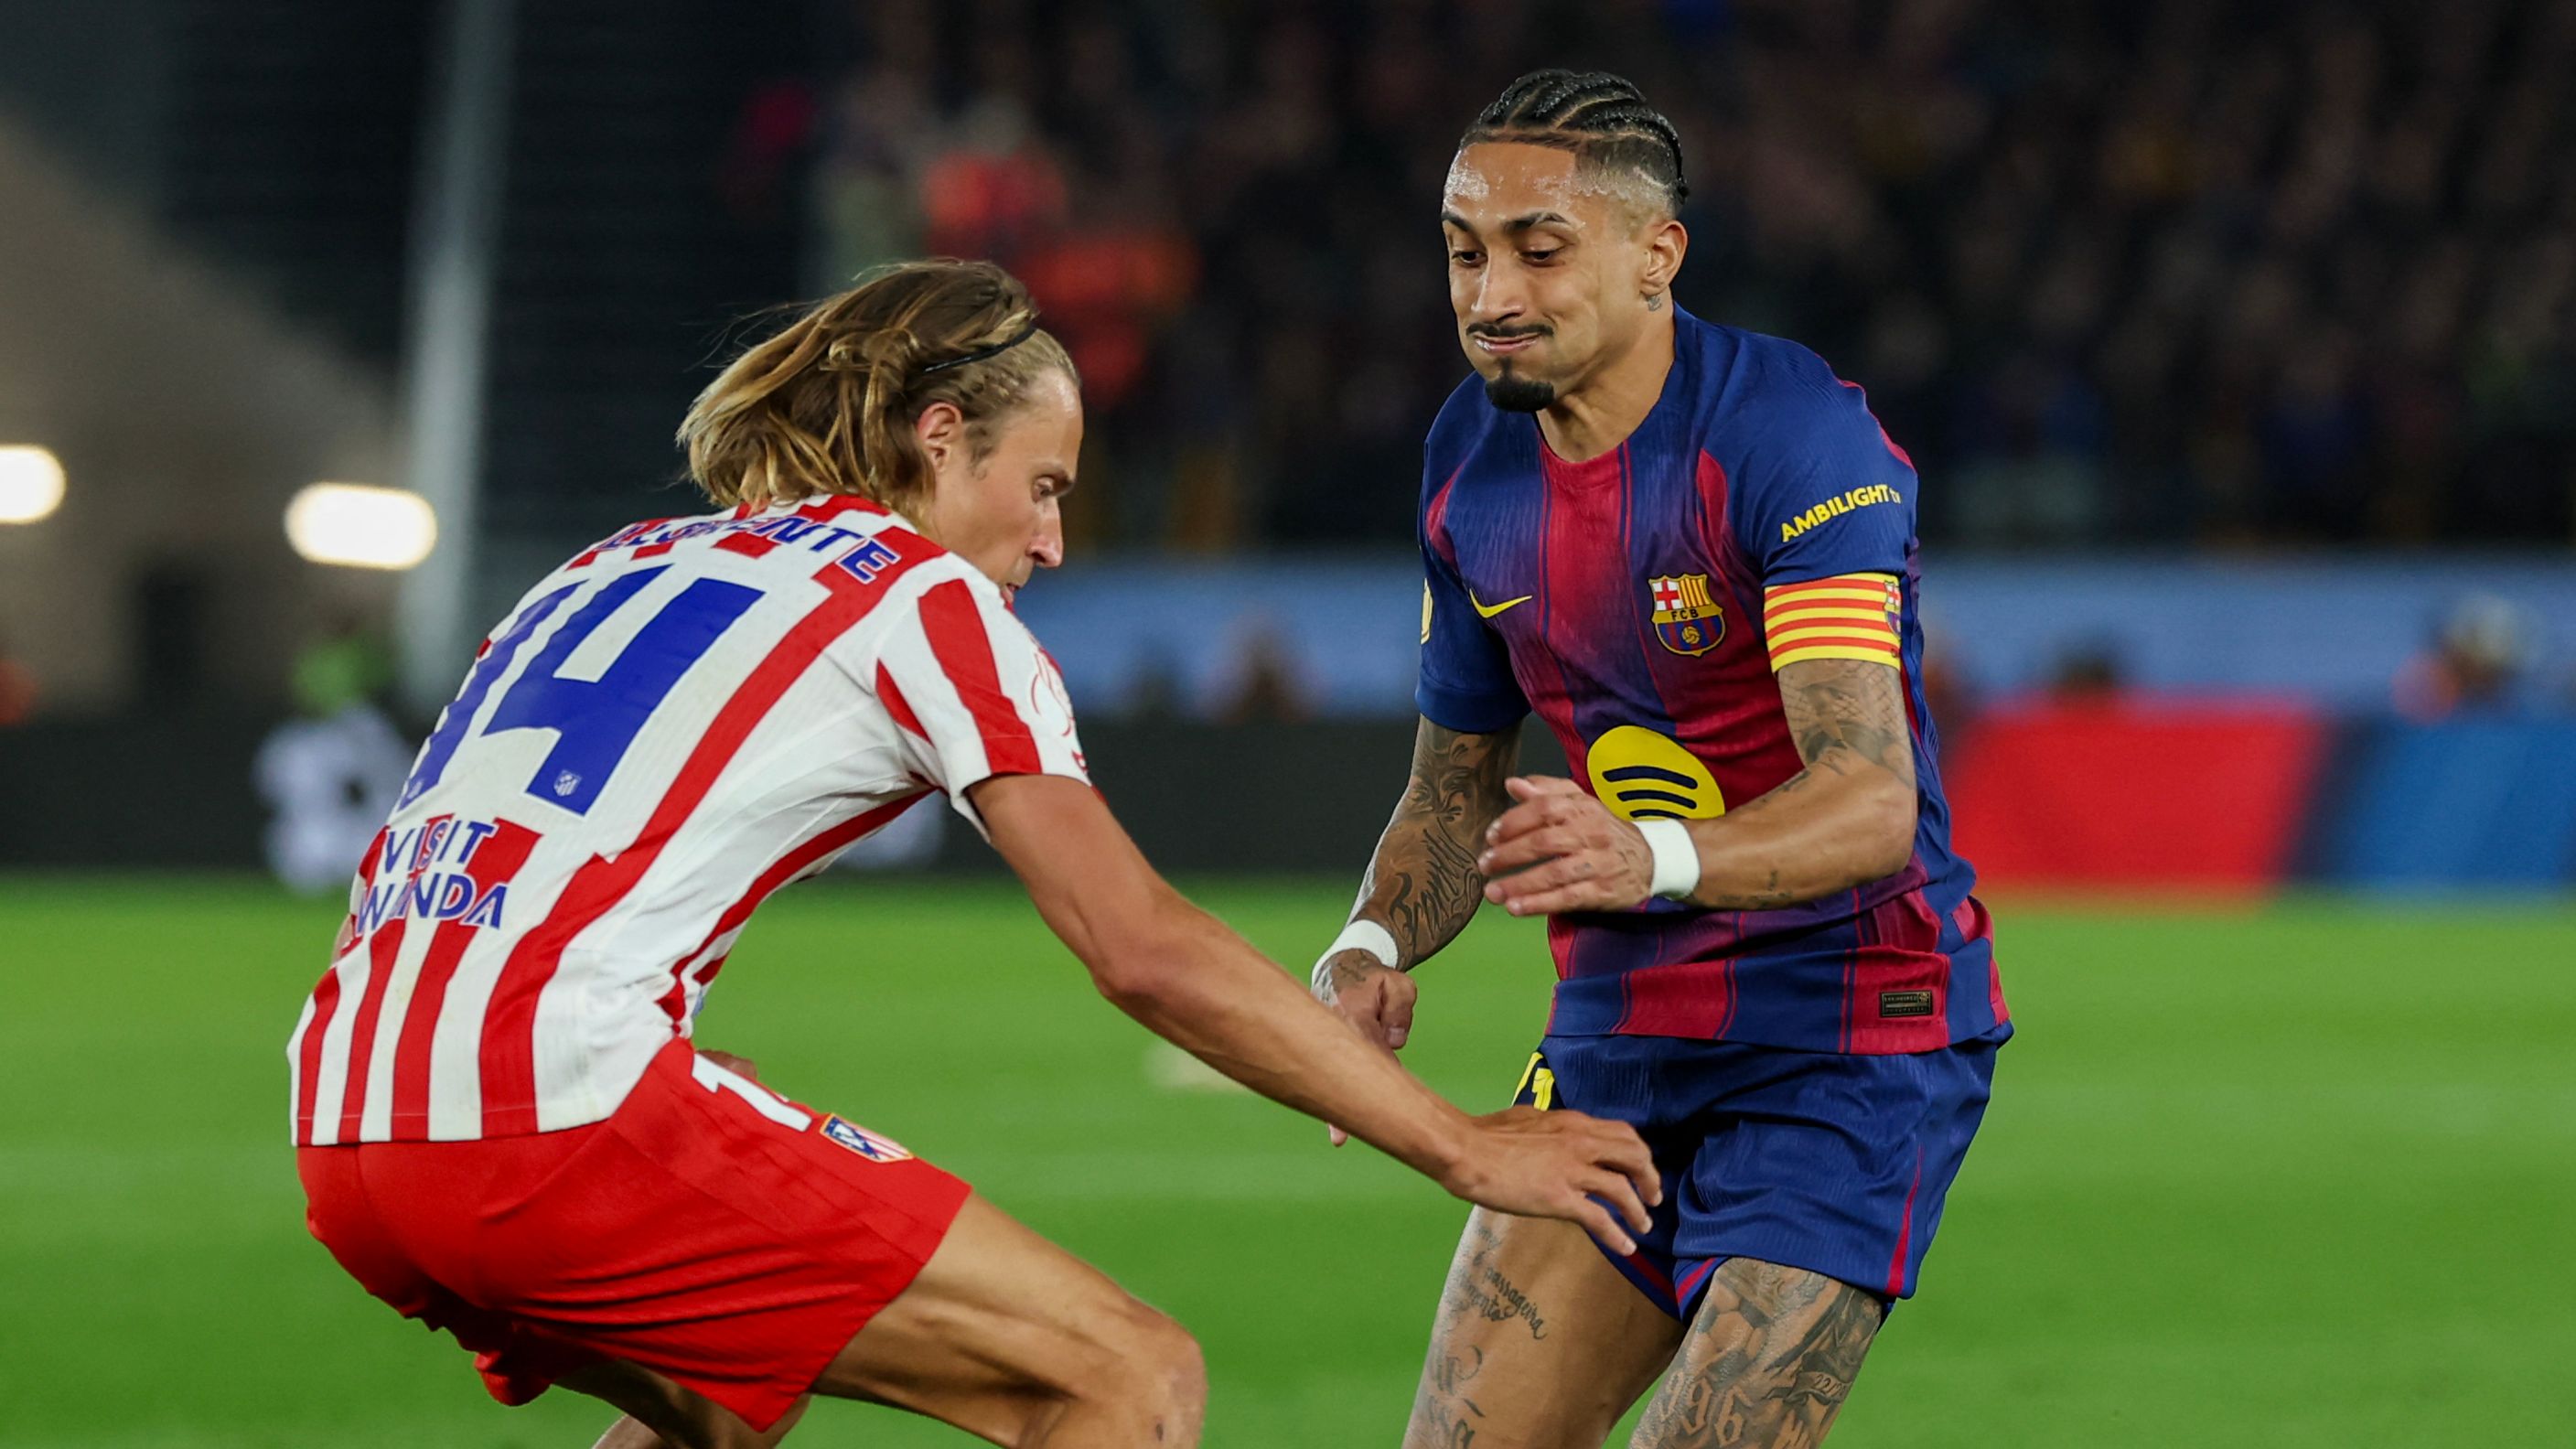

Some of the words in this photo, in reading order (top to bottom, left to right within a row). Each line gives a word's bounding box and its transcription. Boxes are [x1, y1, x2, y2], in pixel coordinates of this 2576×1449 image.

[1781, 484, 1890, 542] AMBILIGHT
[1670, 608, 1699, 621] FCB
[397, 563, 767, 817] 14
[385, 821, 495, 874] VISIT
